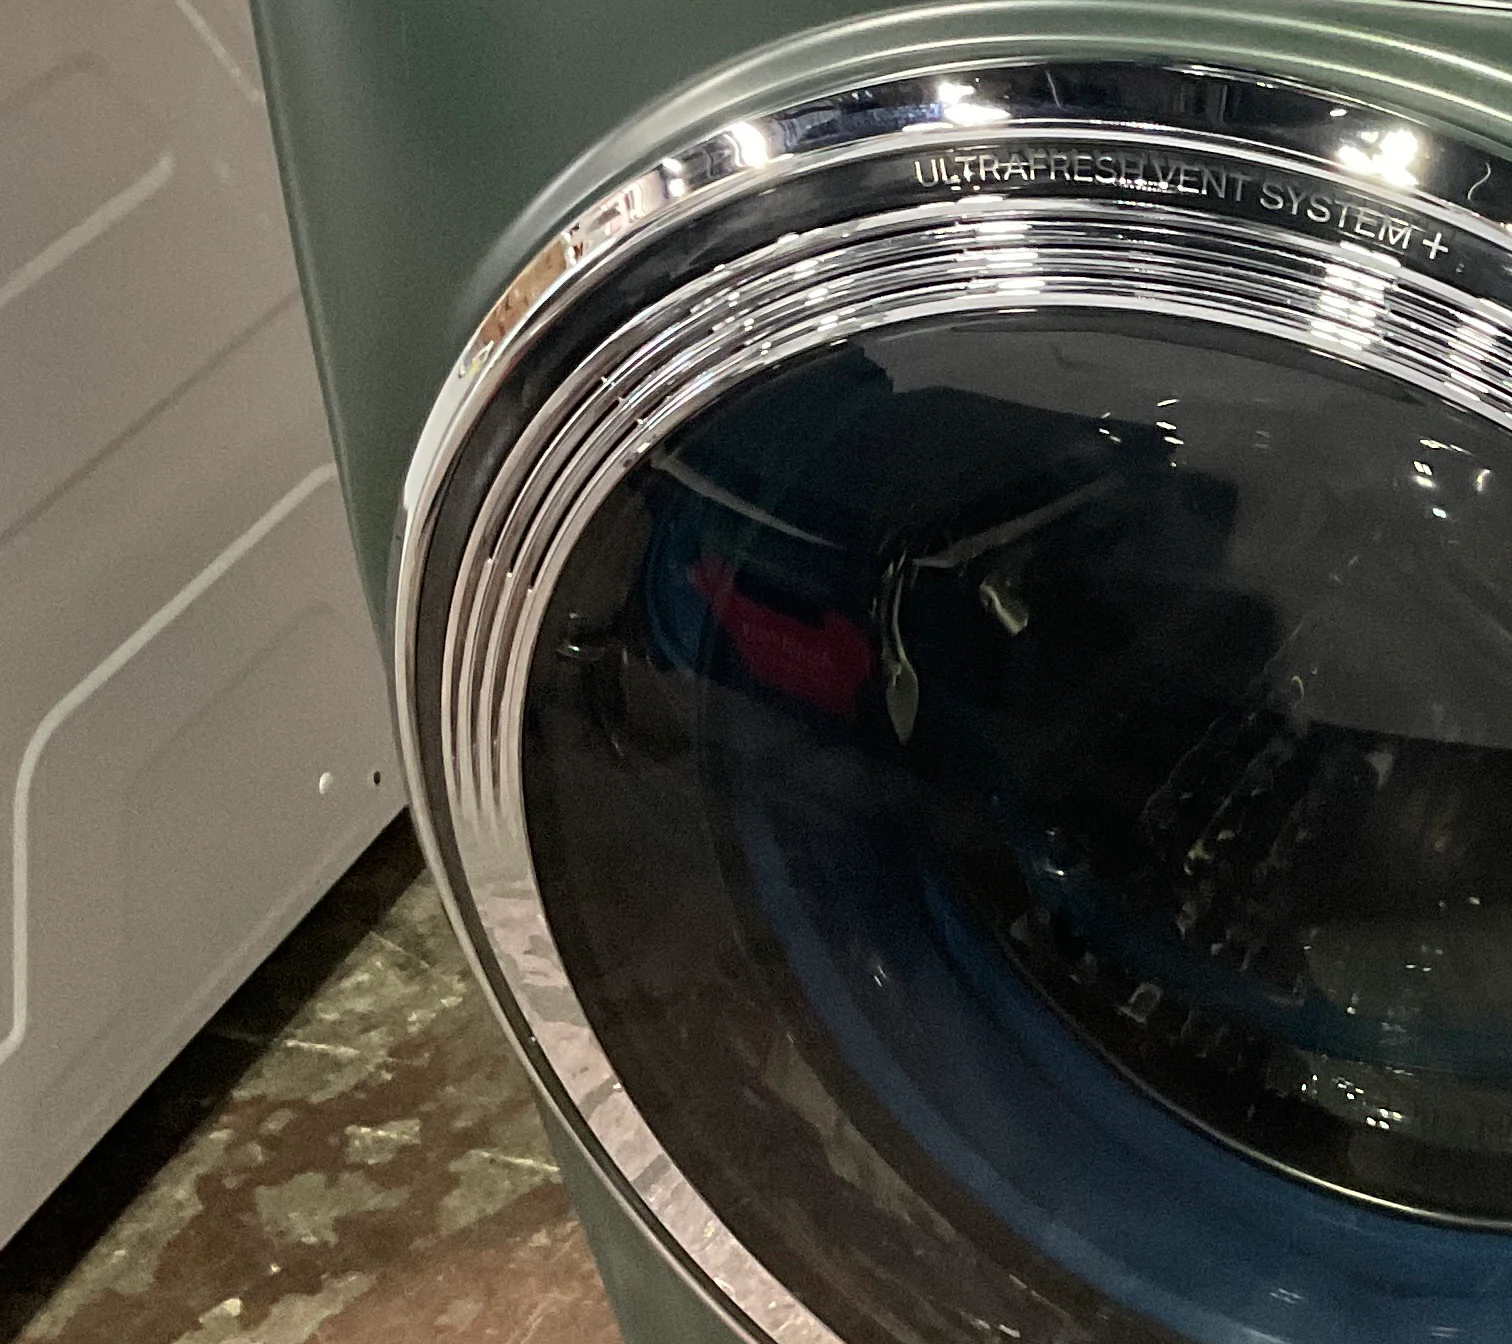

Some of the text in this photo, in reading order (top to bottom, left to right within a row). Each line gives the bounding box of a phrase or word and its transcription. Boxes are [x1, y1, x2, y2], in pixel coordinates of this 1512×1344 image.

[914, 153, 1148, 189] ULTRAFRESH
[1150, 159, 1253, 202] VENT
[1259, 178, 1418, 250] SYSTEM
